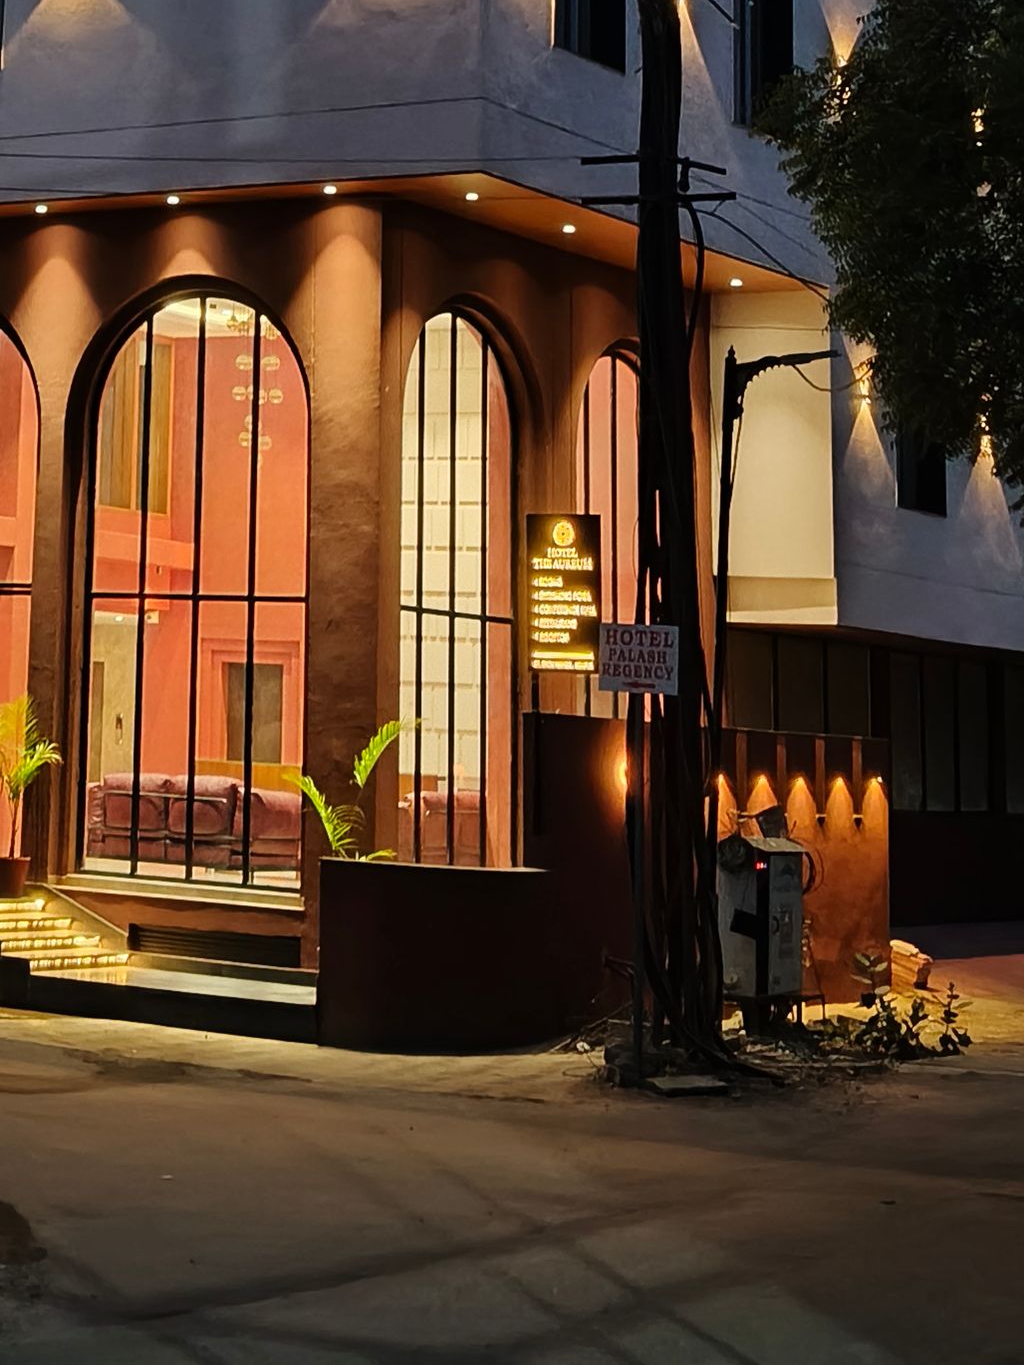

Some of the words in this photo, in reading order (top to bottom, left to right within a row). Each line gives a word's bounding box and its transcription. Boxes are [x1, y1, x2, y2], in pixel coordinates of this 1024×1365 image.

[605, 629, 674, 648] HOTEL
[608, 648, 667, 664] PALASH
[602, 663, 674, 681] REGENCY
